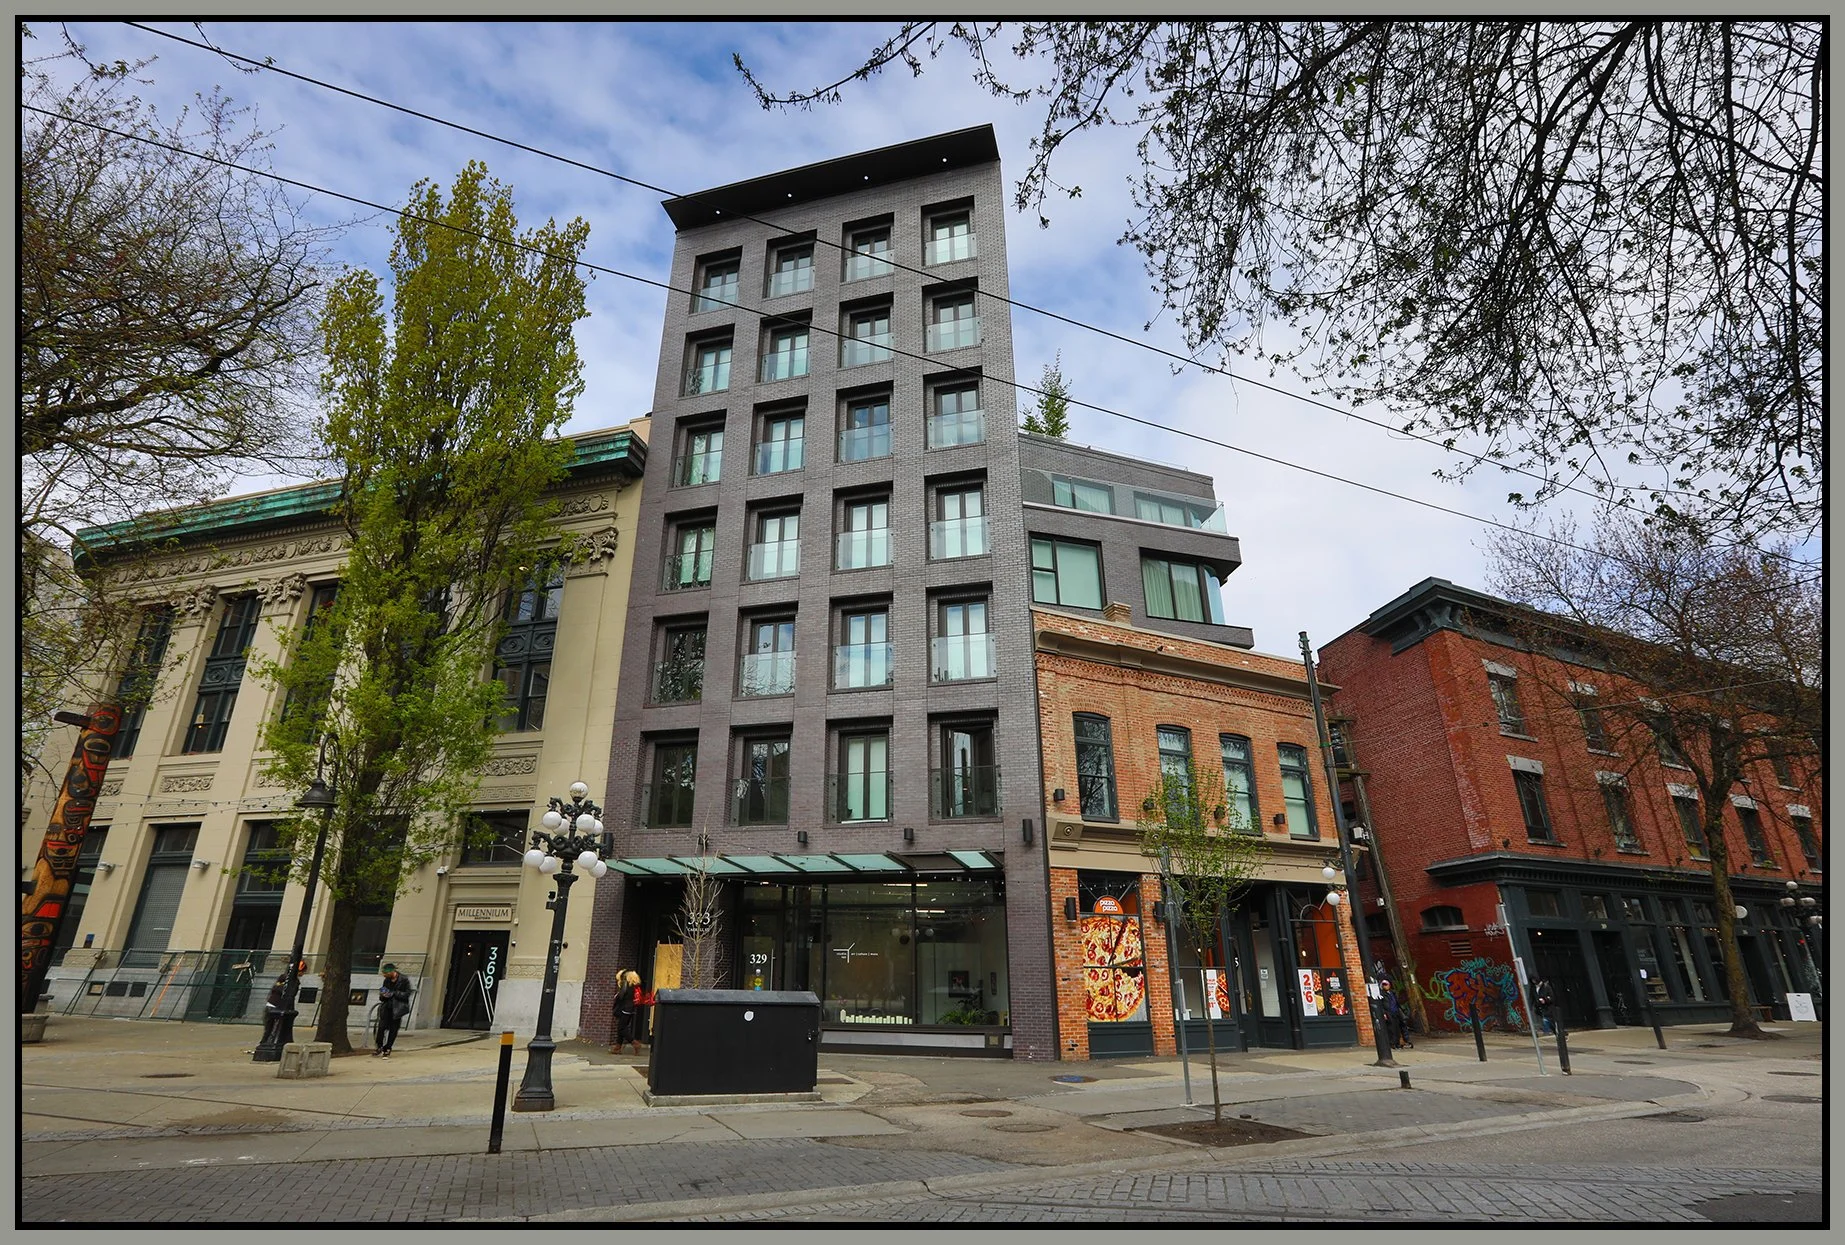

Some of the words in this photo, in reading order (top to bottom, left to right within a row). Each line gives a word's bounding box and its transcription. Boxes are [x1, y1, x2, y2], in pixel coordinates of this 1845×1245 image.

[458, 908, 509, 918] MILLENNIUM
[688, 912, 711, 925] 333
[749, 953, 768, 964] 329
[485, 947, 498, 989] 369
[1303, 974, 1311, 986] 2
